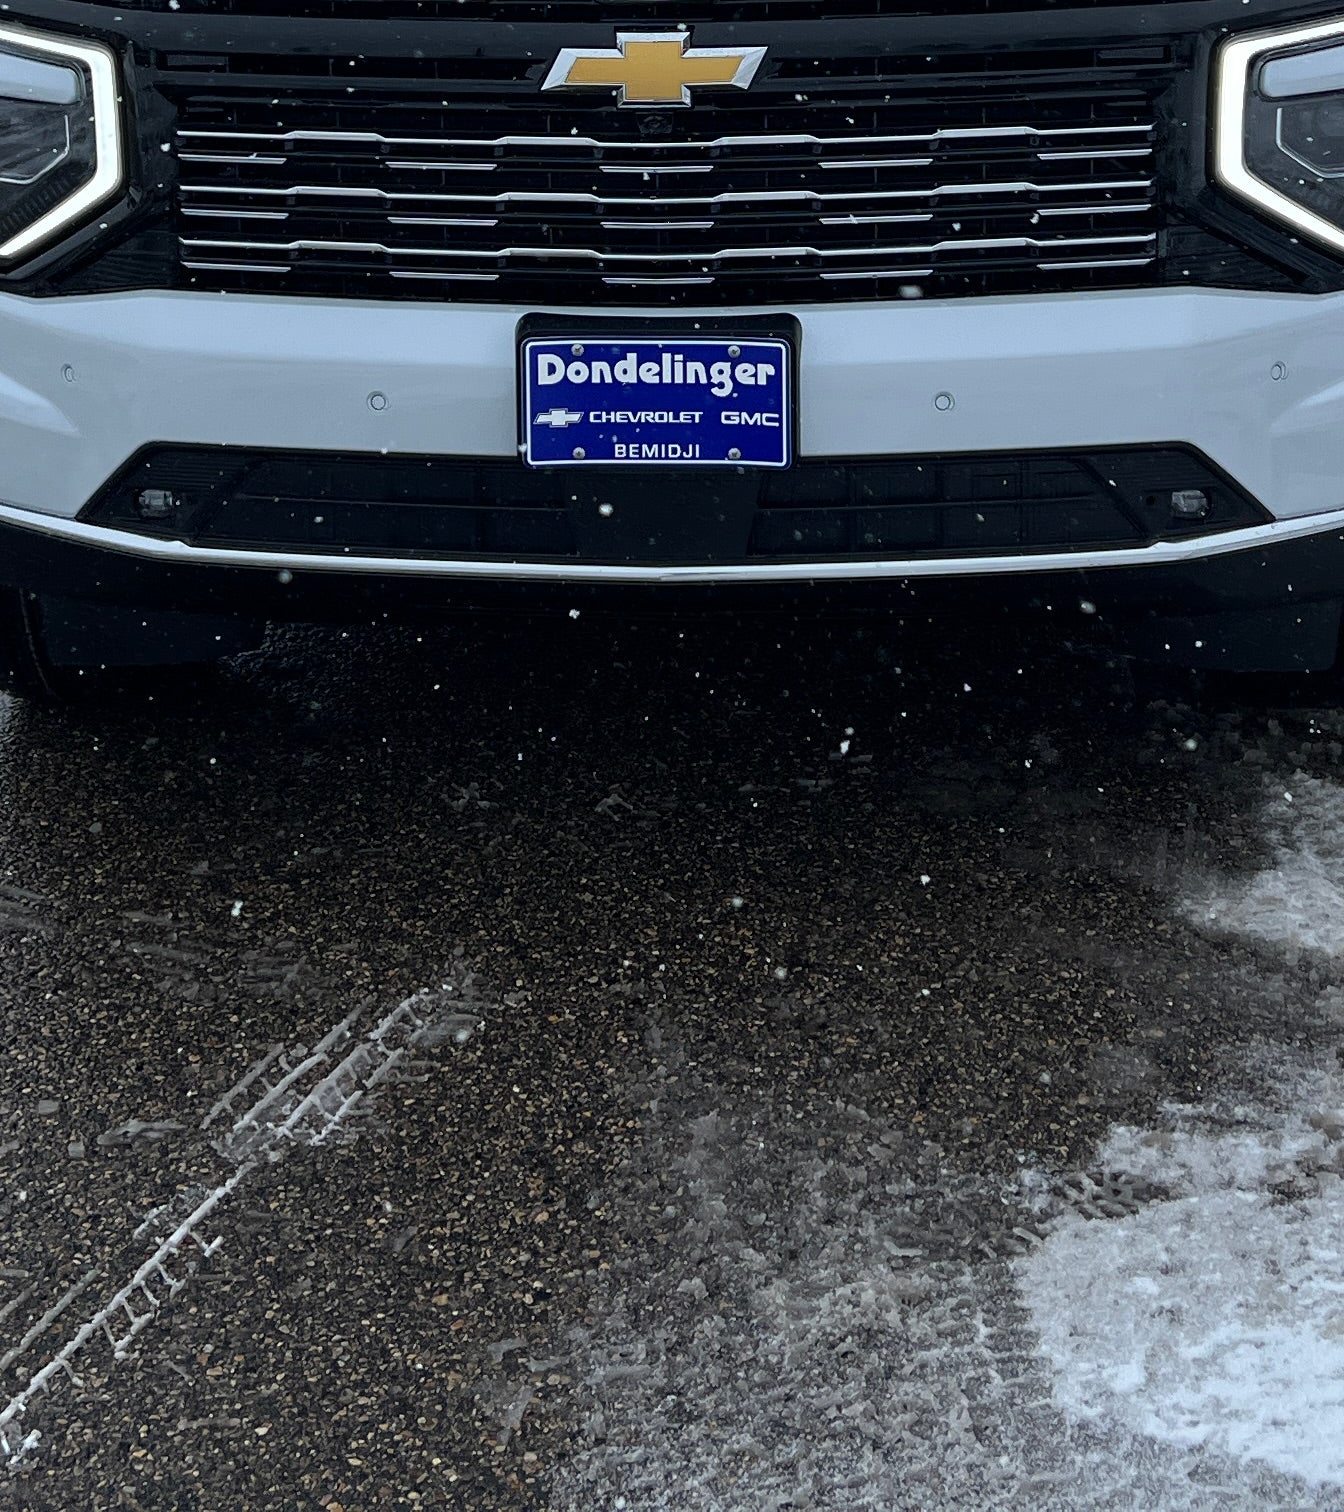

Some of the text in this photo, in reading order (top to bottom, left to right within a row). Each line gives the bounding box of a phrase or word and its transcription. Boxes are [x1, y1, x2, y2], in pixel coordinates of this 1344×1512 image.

[537, 352, 776, 398] Dondelinger
[588, 410, 780, 427] CHEVROLET GMC
[614, 443, 700, 459] BEMIDJI
